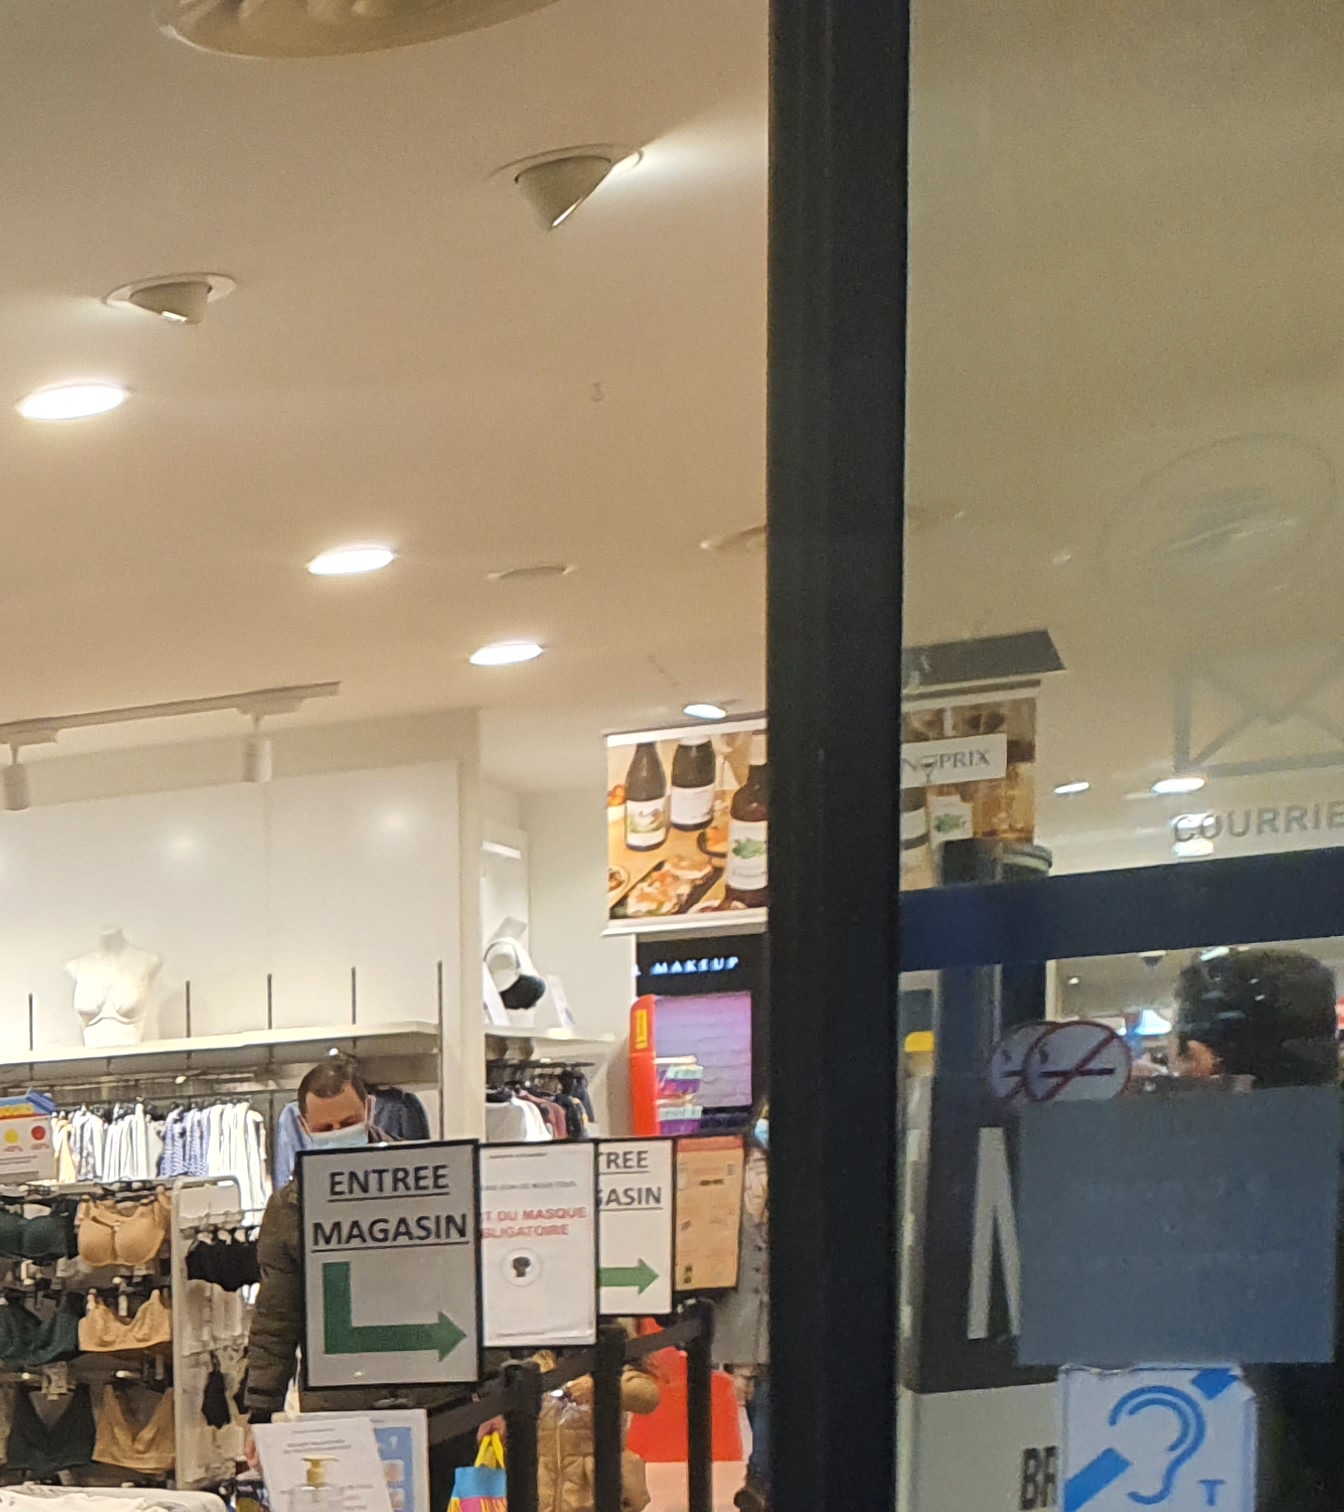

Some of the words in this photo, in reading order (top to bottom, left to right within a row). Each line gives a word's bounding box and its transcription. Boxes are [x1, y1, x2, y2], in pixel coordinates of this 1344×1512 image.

[650, 956, 739, 976] MAKEUP
[328, 1165, 450, 1197] ENTREE
[311, 1212, 468, 1247] MAGASIN
